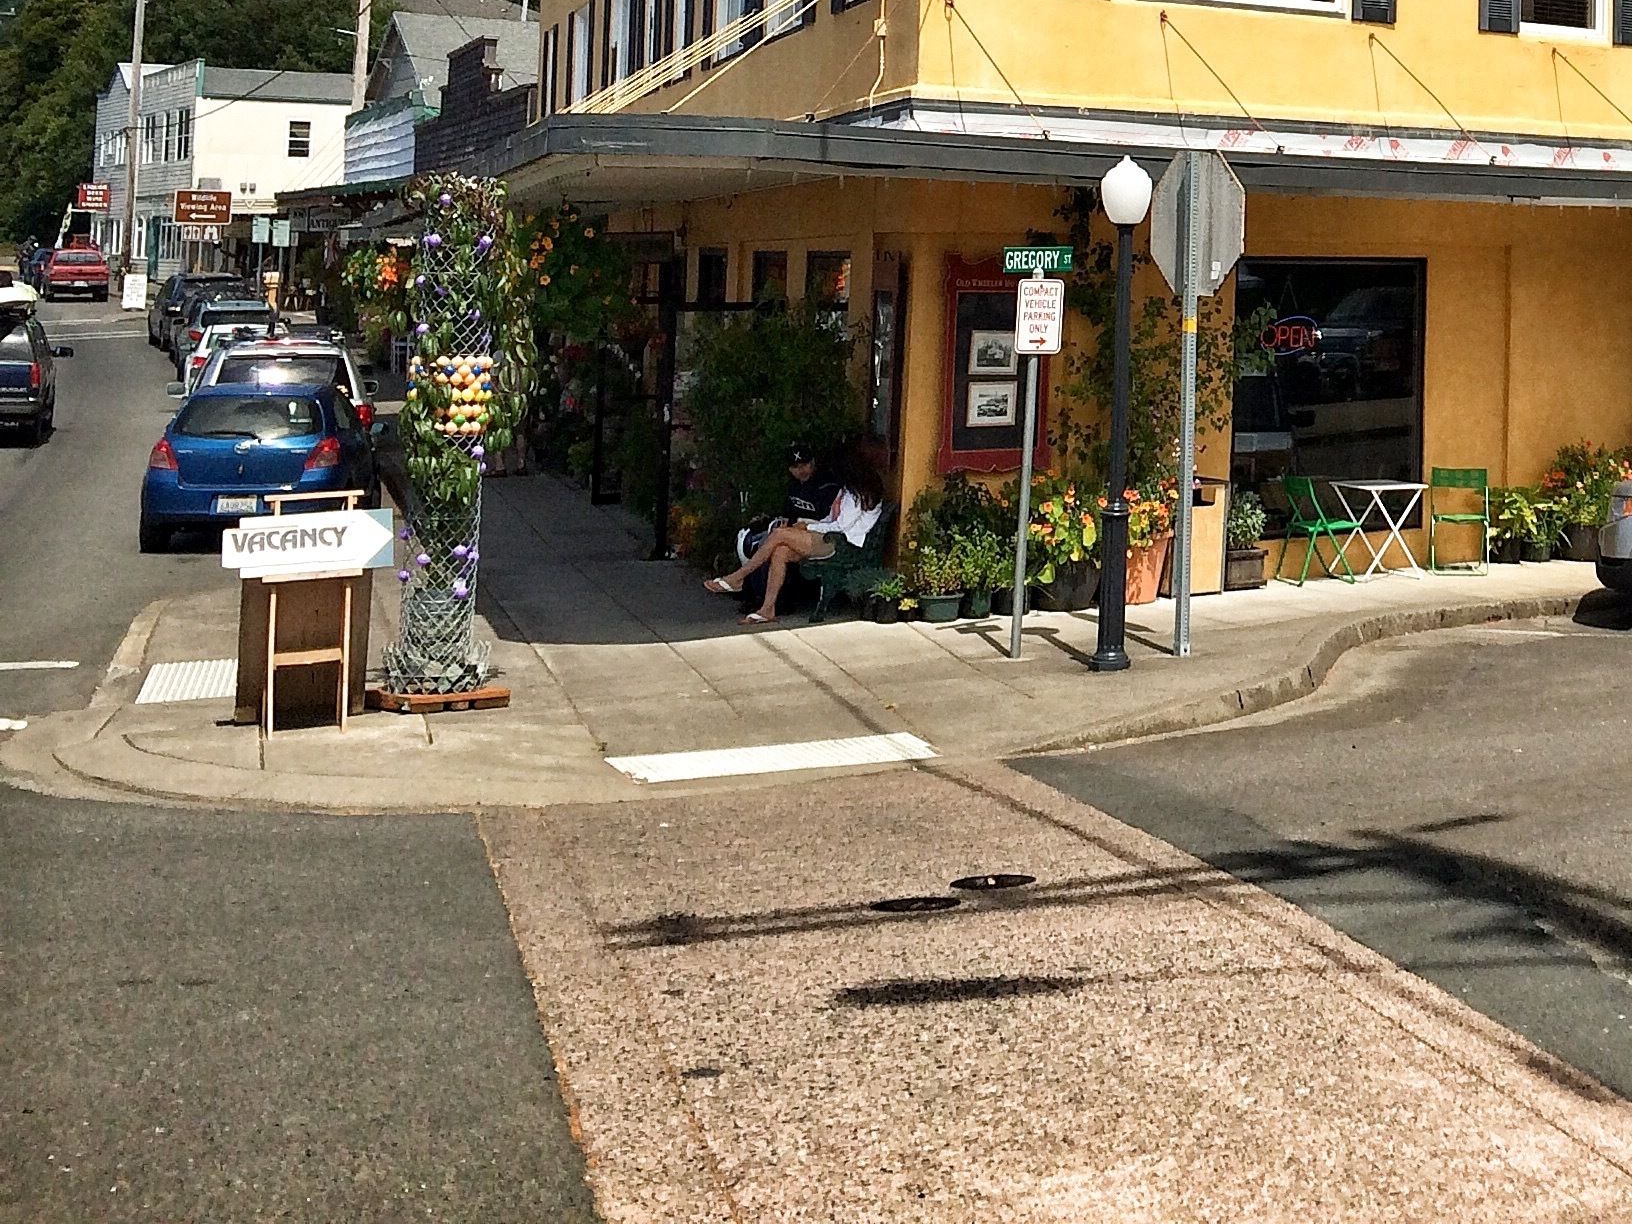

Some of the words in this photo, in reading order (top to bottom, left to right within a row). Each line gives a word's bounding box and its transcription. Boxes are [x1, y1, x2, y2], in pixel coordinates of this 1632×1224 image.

[179, 202, 208, 212] Viewing
[210, 203, 227, 212] Area
[1005, 250, 1060, 270] GREGORY
[1063, 254, 1072, 264] ST
[1023, 286, 1059, 297] COMPACT
[1025, 299, 1056, 309] VEHICLE
[1023, 312, 1056, 322] PARKING
[1029, 324, 1049, 334] ONLY
[1260, 324, 1317, 348] OPEN
[231, 526, 348, 554] VACANCY
